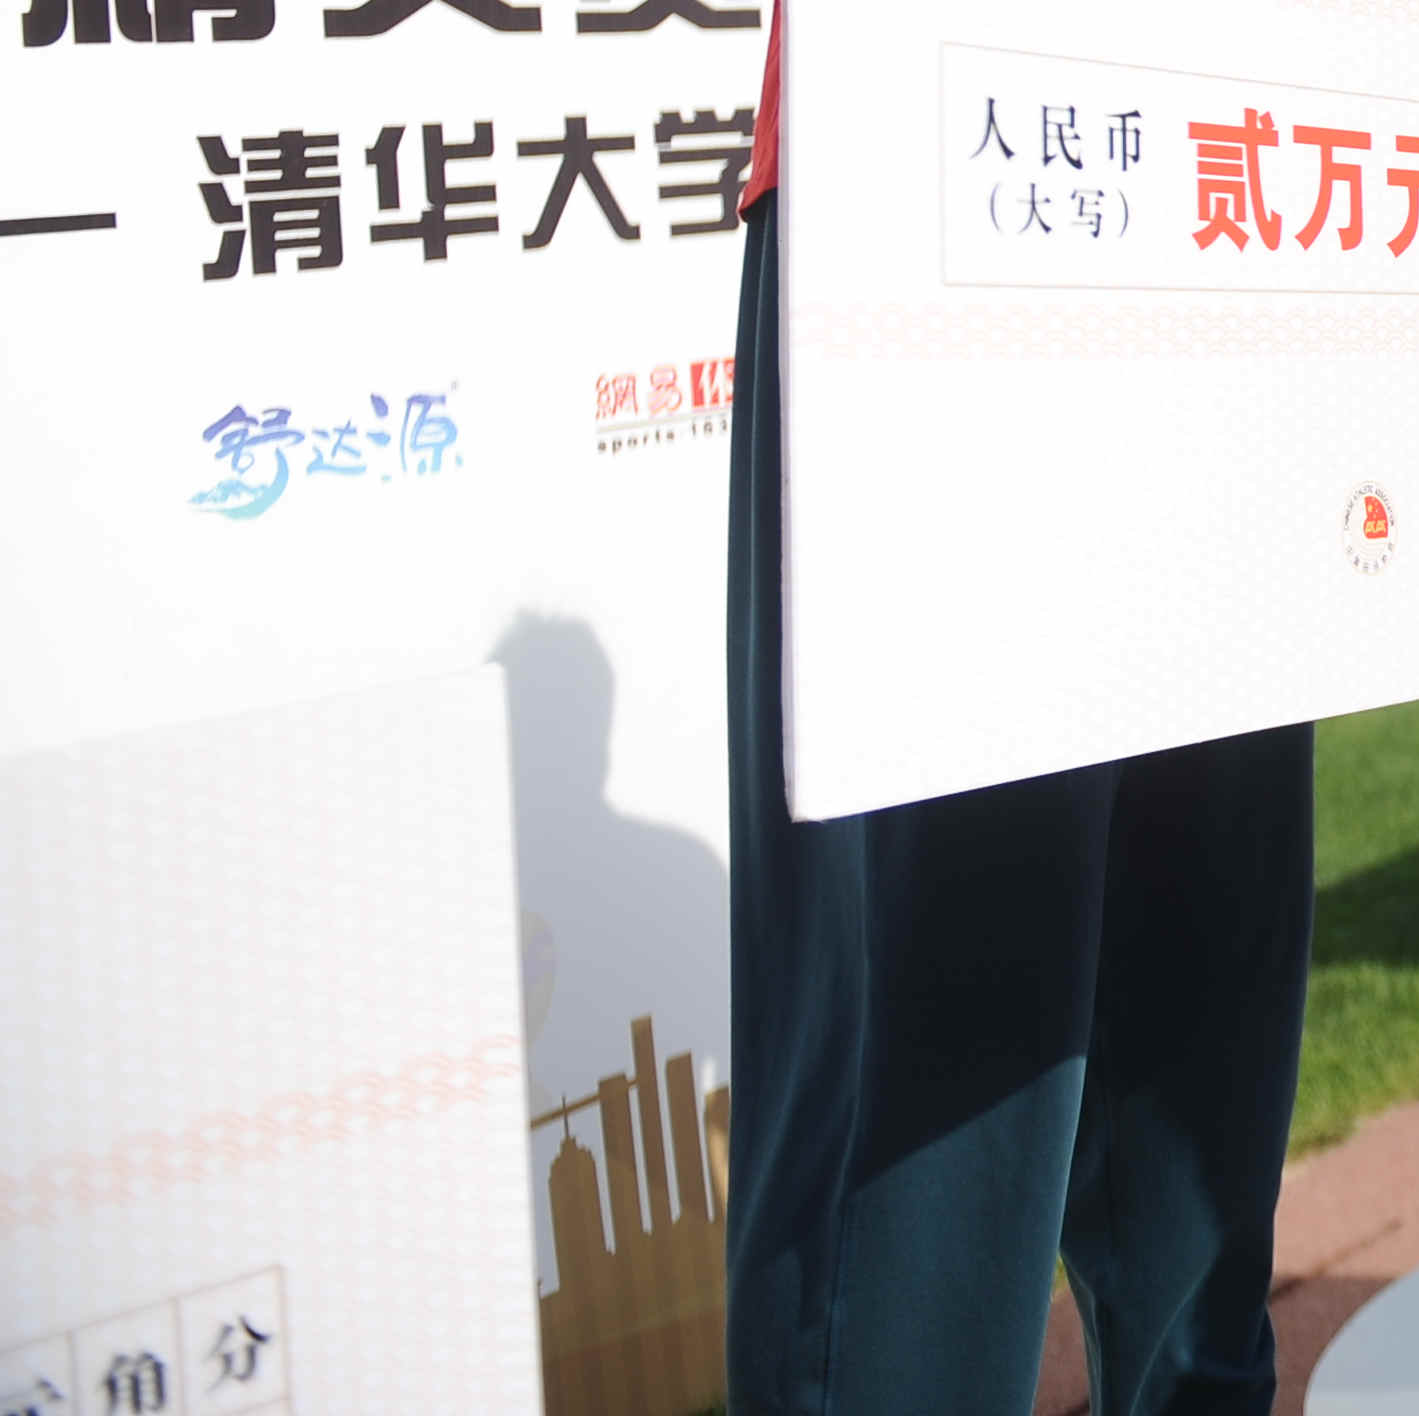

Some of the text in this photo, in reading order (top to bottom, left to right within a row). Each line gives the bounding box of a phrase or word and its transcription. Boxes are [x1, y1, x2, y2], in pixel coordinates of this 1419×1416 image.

[197, 107, 756, 281] 清华大学
[970, 96, 1143, 172] 人民币
[188, 391, 464, 520] 舒达源
